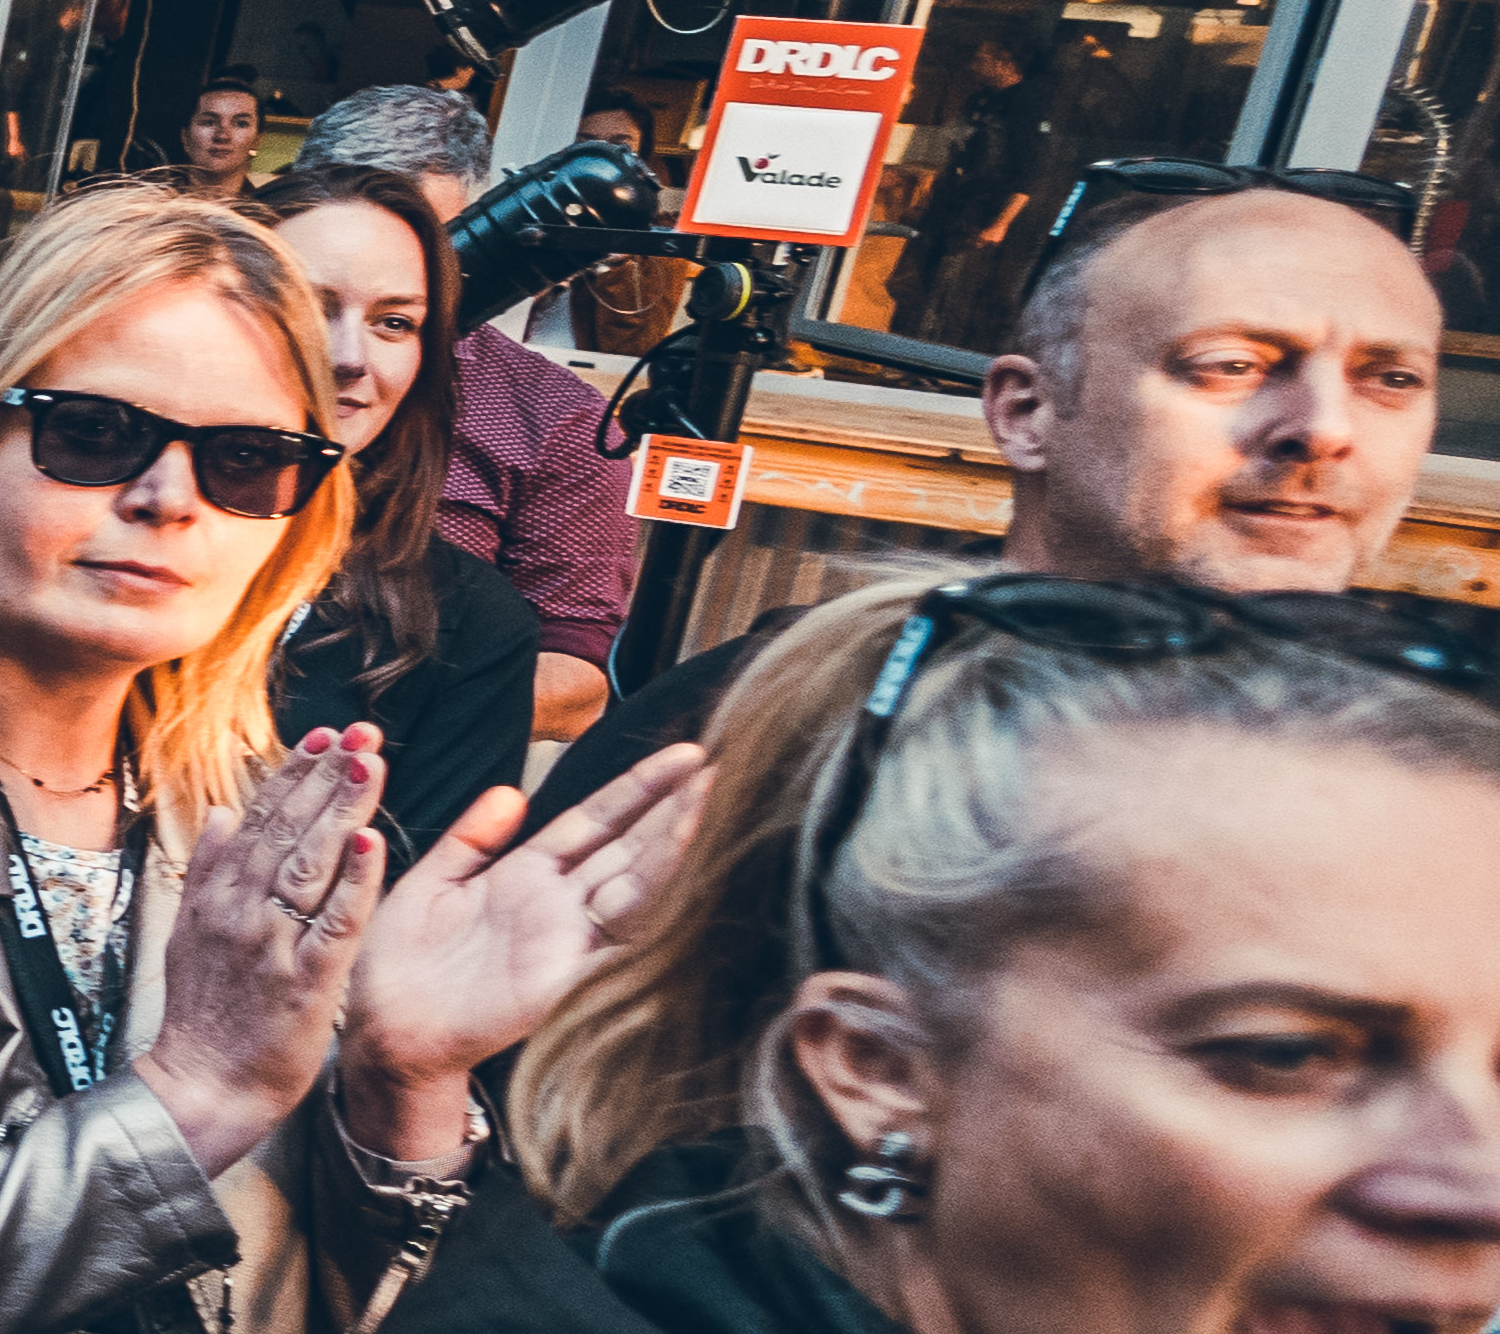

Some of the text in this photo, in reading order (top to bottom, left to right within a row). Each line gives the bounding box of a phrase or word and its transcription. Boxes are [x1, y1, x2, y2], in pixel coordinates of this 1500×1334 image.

[736, 38, 901, 81] DRDLC
[736, 154, 842, 189] Valade
[51, 1006, 93, 1092] DRDLC
